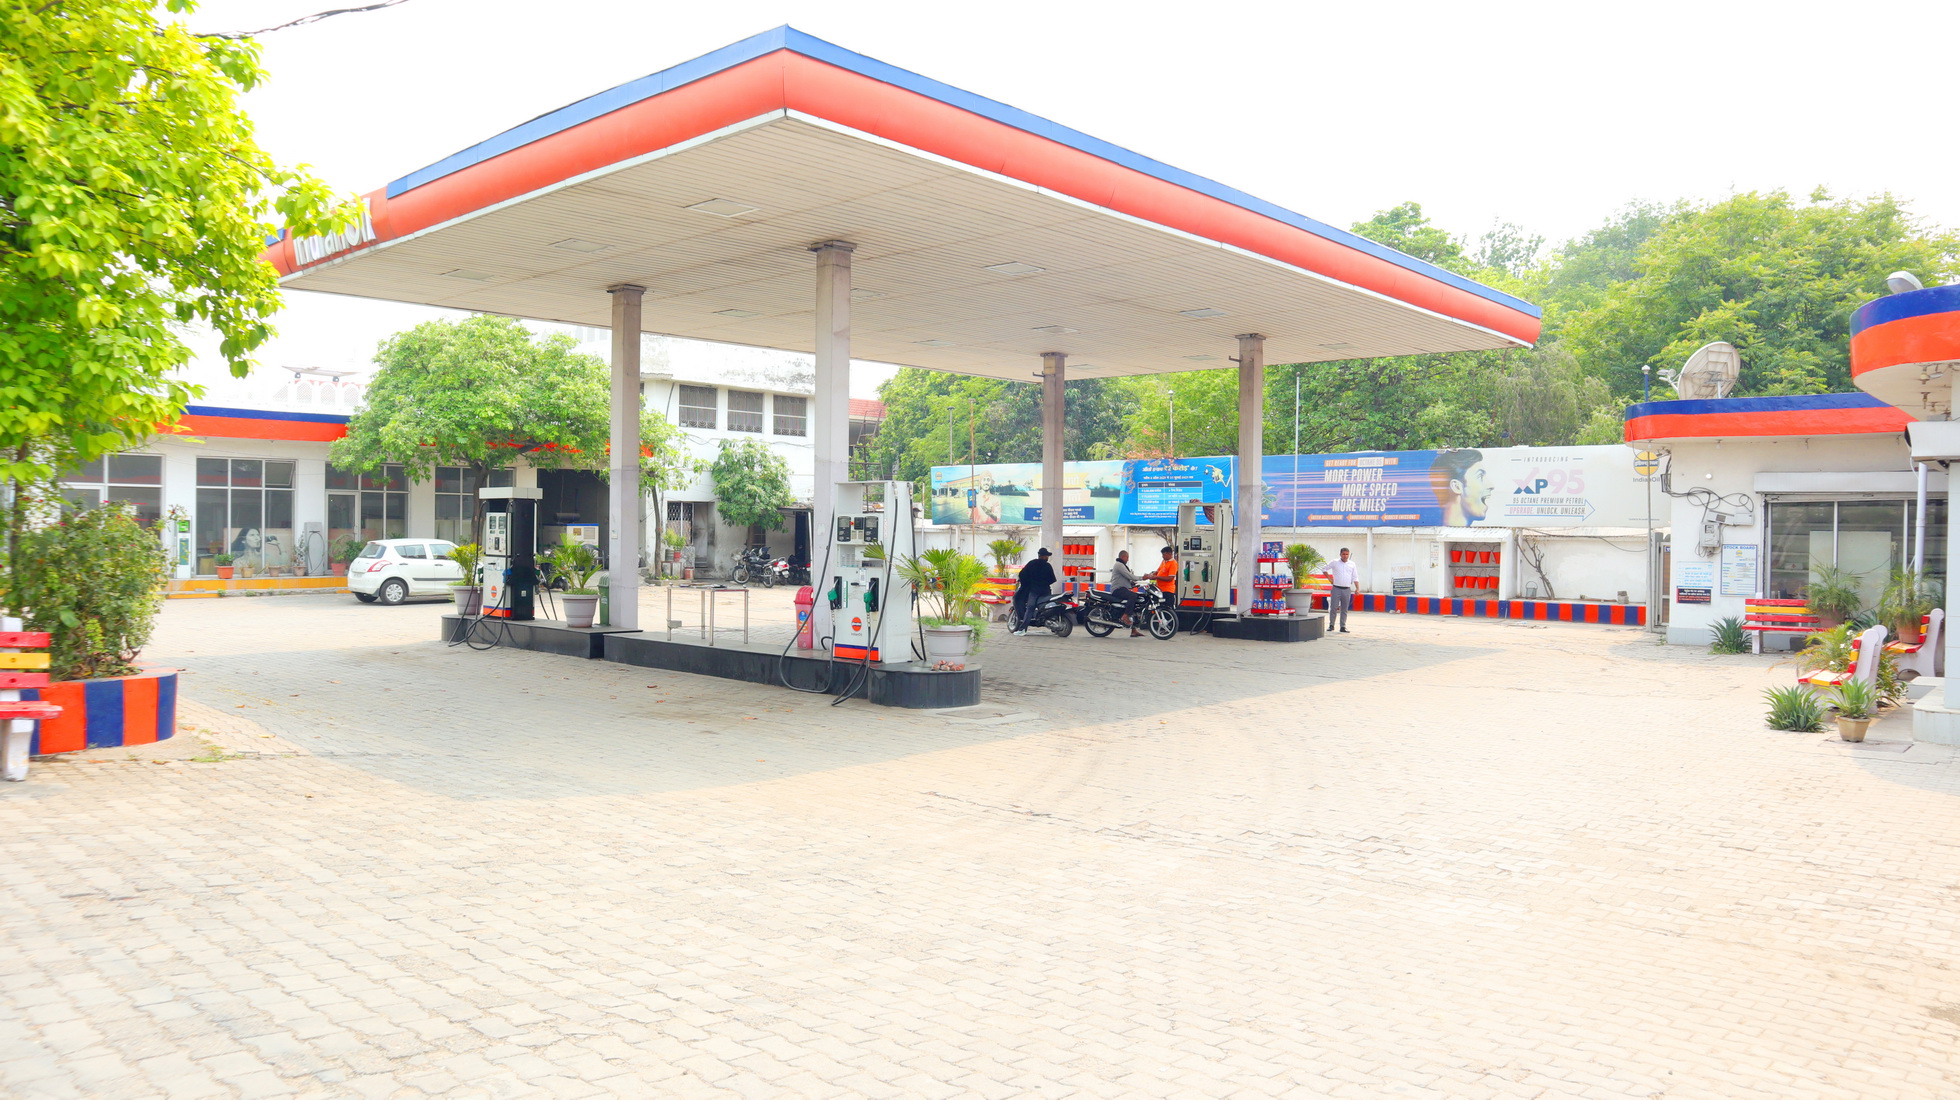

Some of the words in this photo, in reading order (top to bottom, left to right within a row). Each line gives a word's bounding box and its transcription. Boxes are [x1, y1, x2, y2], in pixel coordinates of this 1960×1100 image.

[1325, 469, 1349, 482] MORE
[1351, 468, 1383, 482] POWER
[1512, 467, 1585, 495] XP95
[1342, 483, 1367, 496] MORE
[1369, 482, 1398, 496] SPEED
[1332, 499, 1357, 512] MORE
